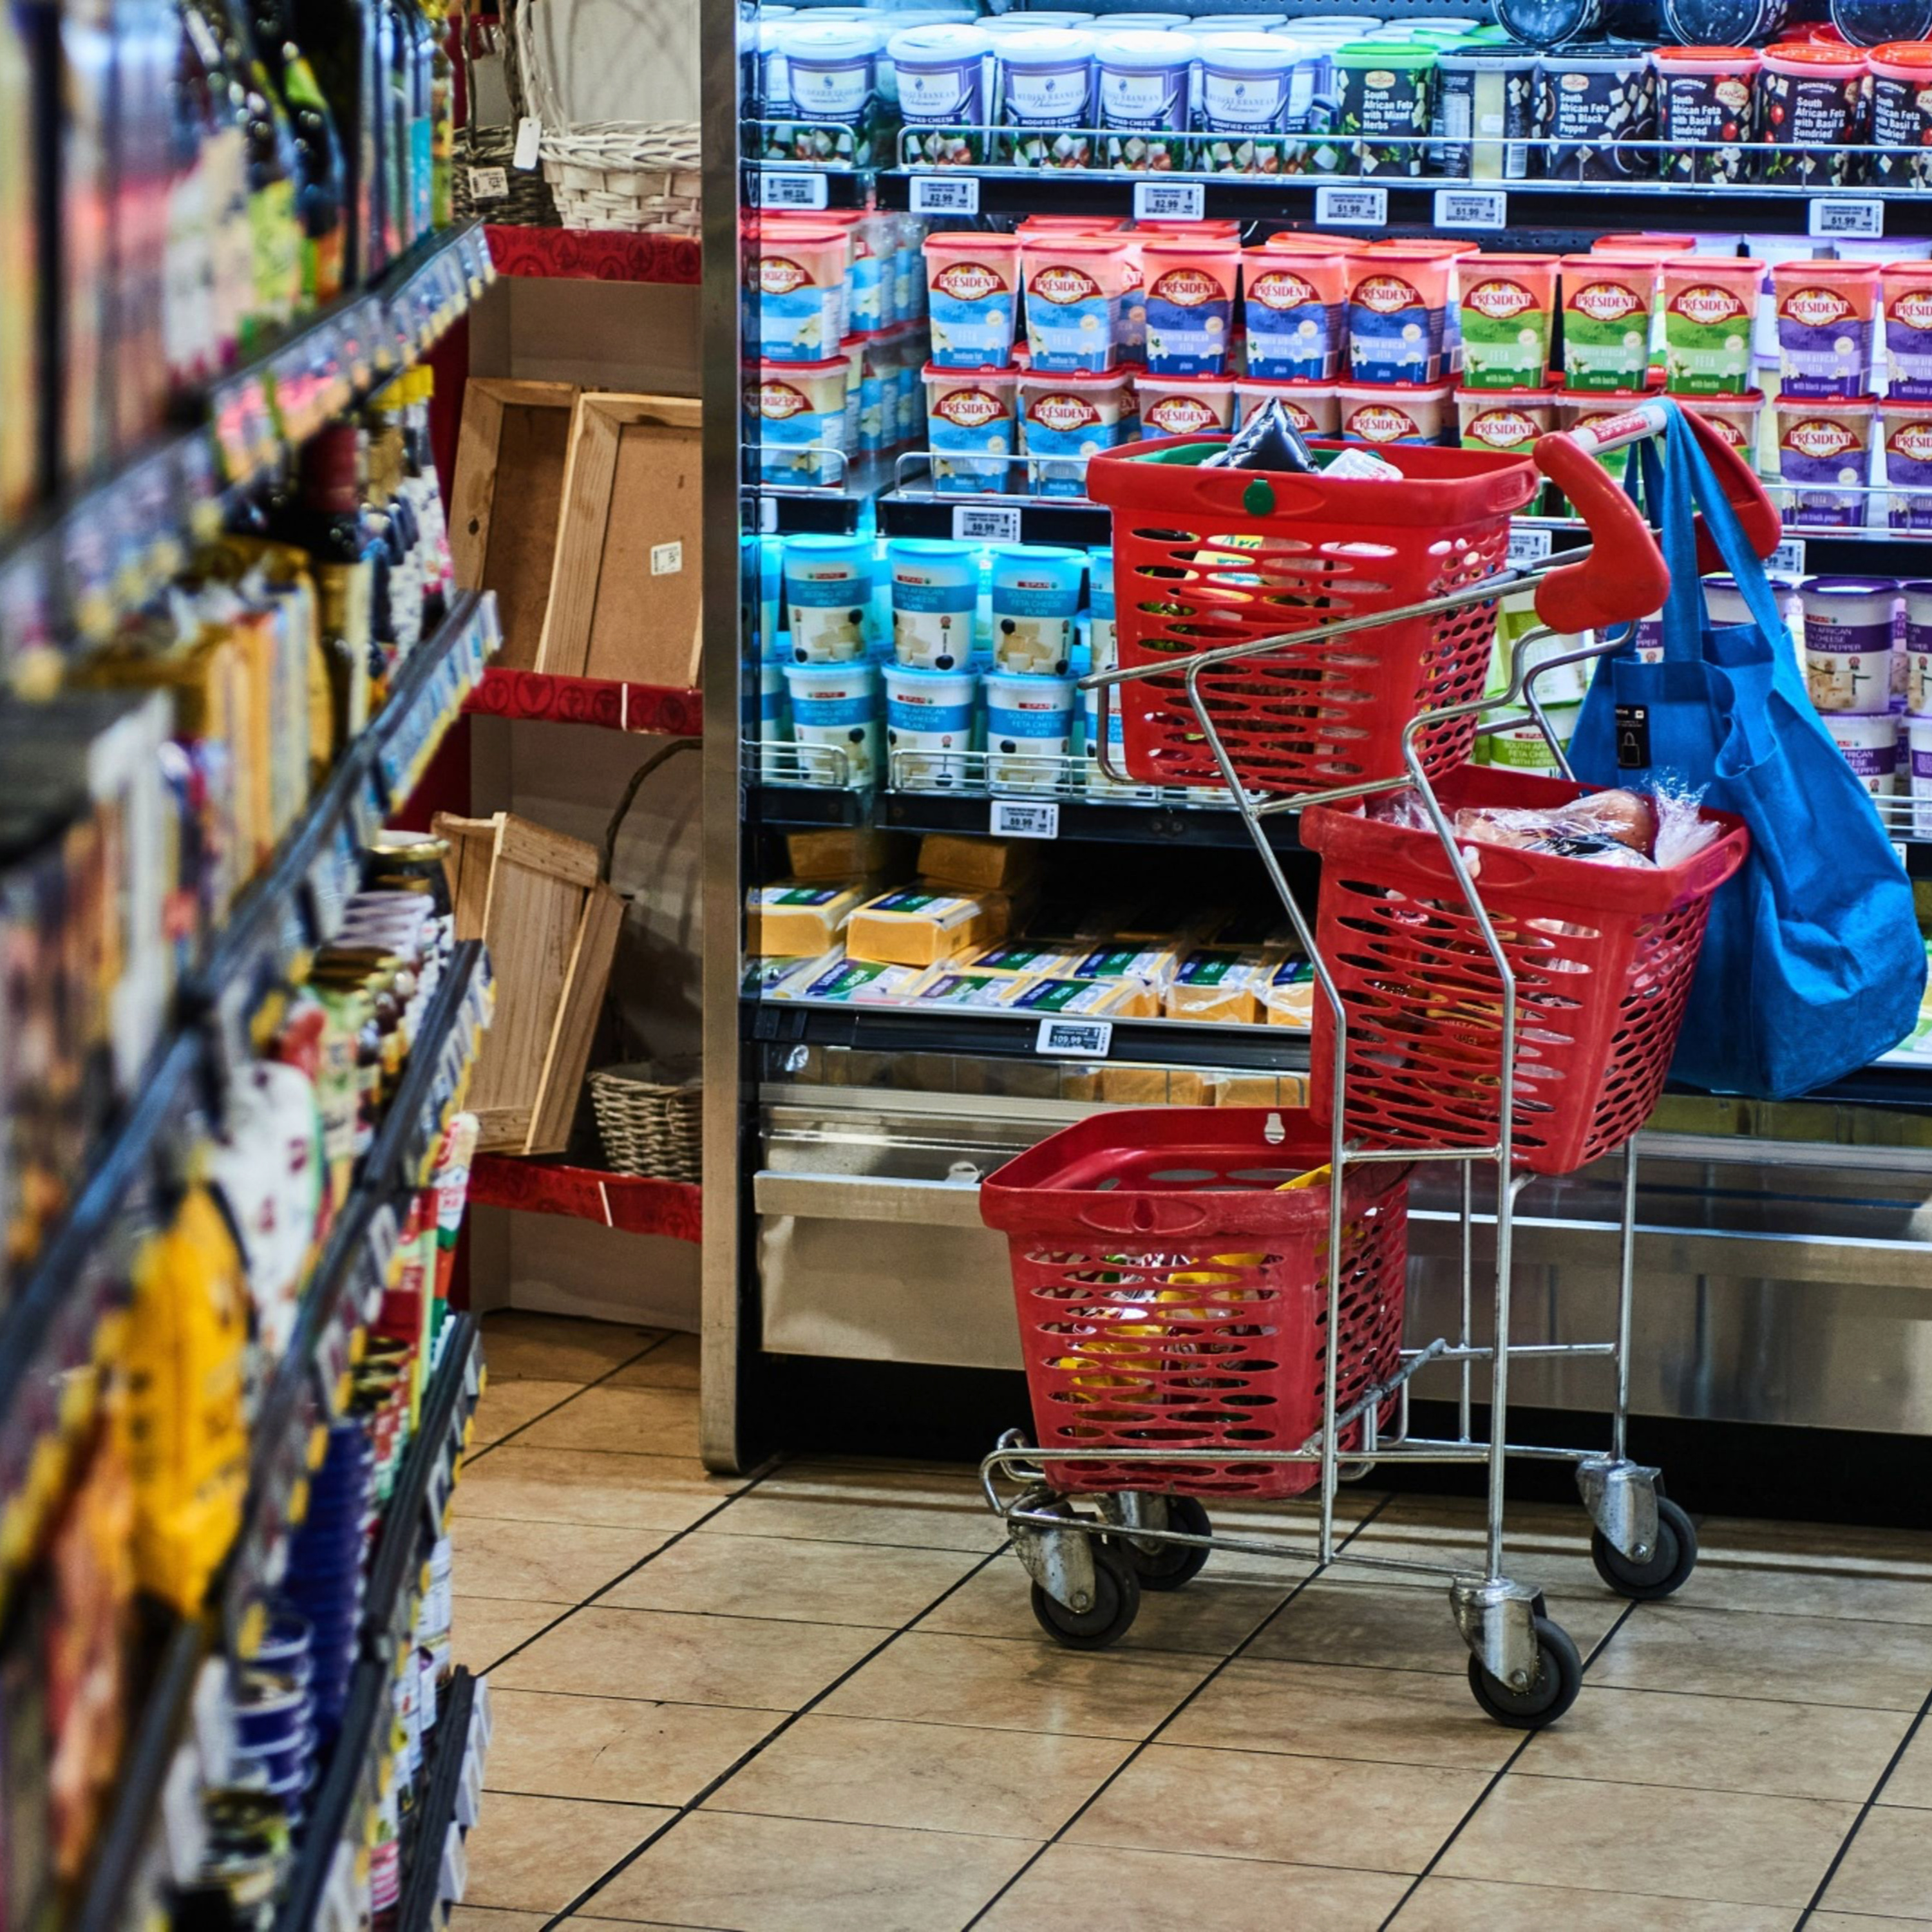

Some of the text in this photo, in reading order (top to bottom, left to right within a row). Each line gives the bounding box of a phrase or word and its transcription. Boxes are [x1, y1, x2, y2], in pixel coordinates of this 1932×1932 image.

[1363, 90, 1389, 100] South
[1559, 93, 1583, 103] South
[1672, 95, 1694, 105] South
[1363, 100, 1414, 110] African Feta
[1796, 97, 1823, 108] South
[1875, 95, 1895, 108] South
[1559, 103, 1609, 113] African Feta
[1671, 105, 1722, 115] African Feta
[1795, 108, 1846, 118] African Feta
[1875, 106, 1920, 120] African Feta
[1363, 110, 1410, 120] with Mixed
[1559, 113, 1604, 123] with Black
[1671, 115, 1722, 126] with Basil &
[1363, 120, 1389, 131] Herbs
[1794, 117, 1845, 128] with Basil &
[1888, 118, 1911, 129] Basil
[1912, 120, 1921, 130] &
[1559, 123, 1588, 134] Pepper
[1671, 125, 1708, 135] Sundried
[1793, 127, 1833, 138] Sundried
[1875, 126, 1906, 138] Sundried
[1337, 204, 1361, 213] 51.99
[1455, 206, 1480, 216] 51.99
[1831, 216, 1856, 225] 51.99
[940, 274, 998, 289] PRÉSIDENT
[1036, 276, 1093, 292] PRÉSIDENT
[1159, 279, 1218, 294] PRÉSIDENT
[1255, 283, 1311, 298] PRÉSIDENT
[1358, 285, 1415, 301] PRÉSIDENT
[1472, 292, 1531, 307] PRÉSIDENT
[1577, 294, 1636, 308] PRÉSIDENT
[1678, 296, 1738, 312] PRÉSIDENT
[1787, 299, 1847, 314] PRÉSIDENT
[1896, 303, 1932, 317] PRÉSID
[1490, 349, 1509, 362] FETA
[1695, 356, 1715, 368] FETA
[1808, 363, 1823, 374] FETA
[1793, 382, 1804, 391] with
[1804, 382, 1819, 392] black
[942, 400, 1000, 415] PRÉSIDENT
[1153, 408, 1212, 424] PRÉSIDENT
[1354, 415, 1410, 431] PRÉSIDENT
[1474, 420, 1534, 435] PRÉSIDENT
[1791, 431, 1852, 446] PRÉSIDENT
[1896, 433, 1932, 450] PRÉSID
[1817, 634, 1846, 643] CHEESE
[1504, 741, 1531, 750] SOUTH
[1508, 749, 1528, 758] FETA
[1843, 750, 1874, 759] FRICAN
[1053, 1034, 1082, 1045] 109.99
